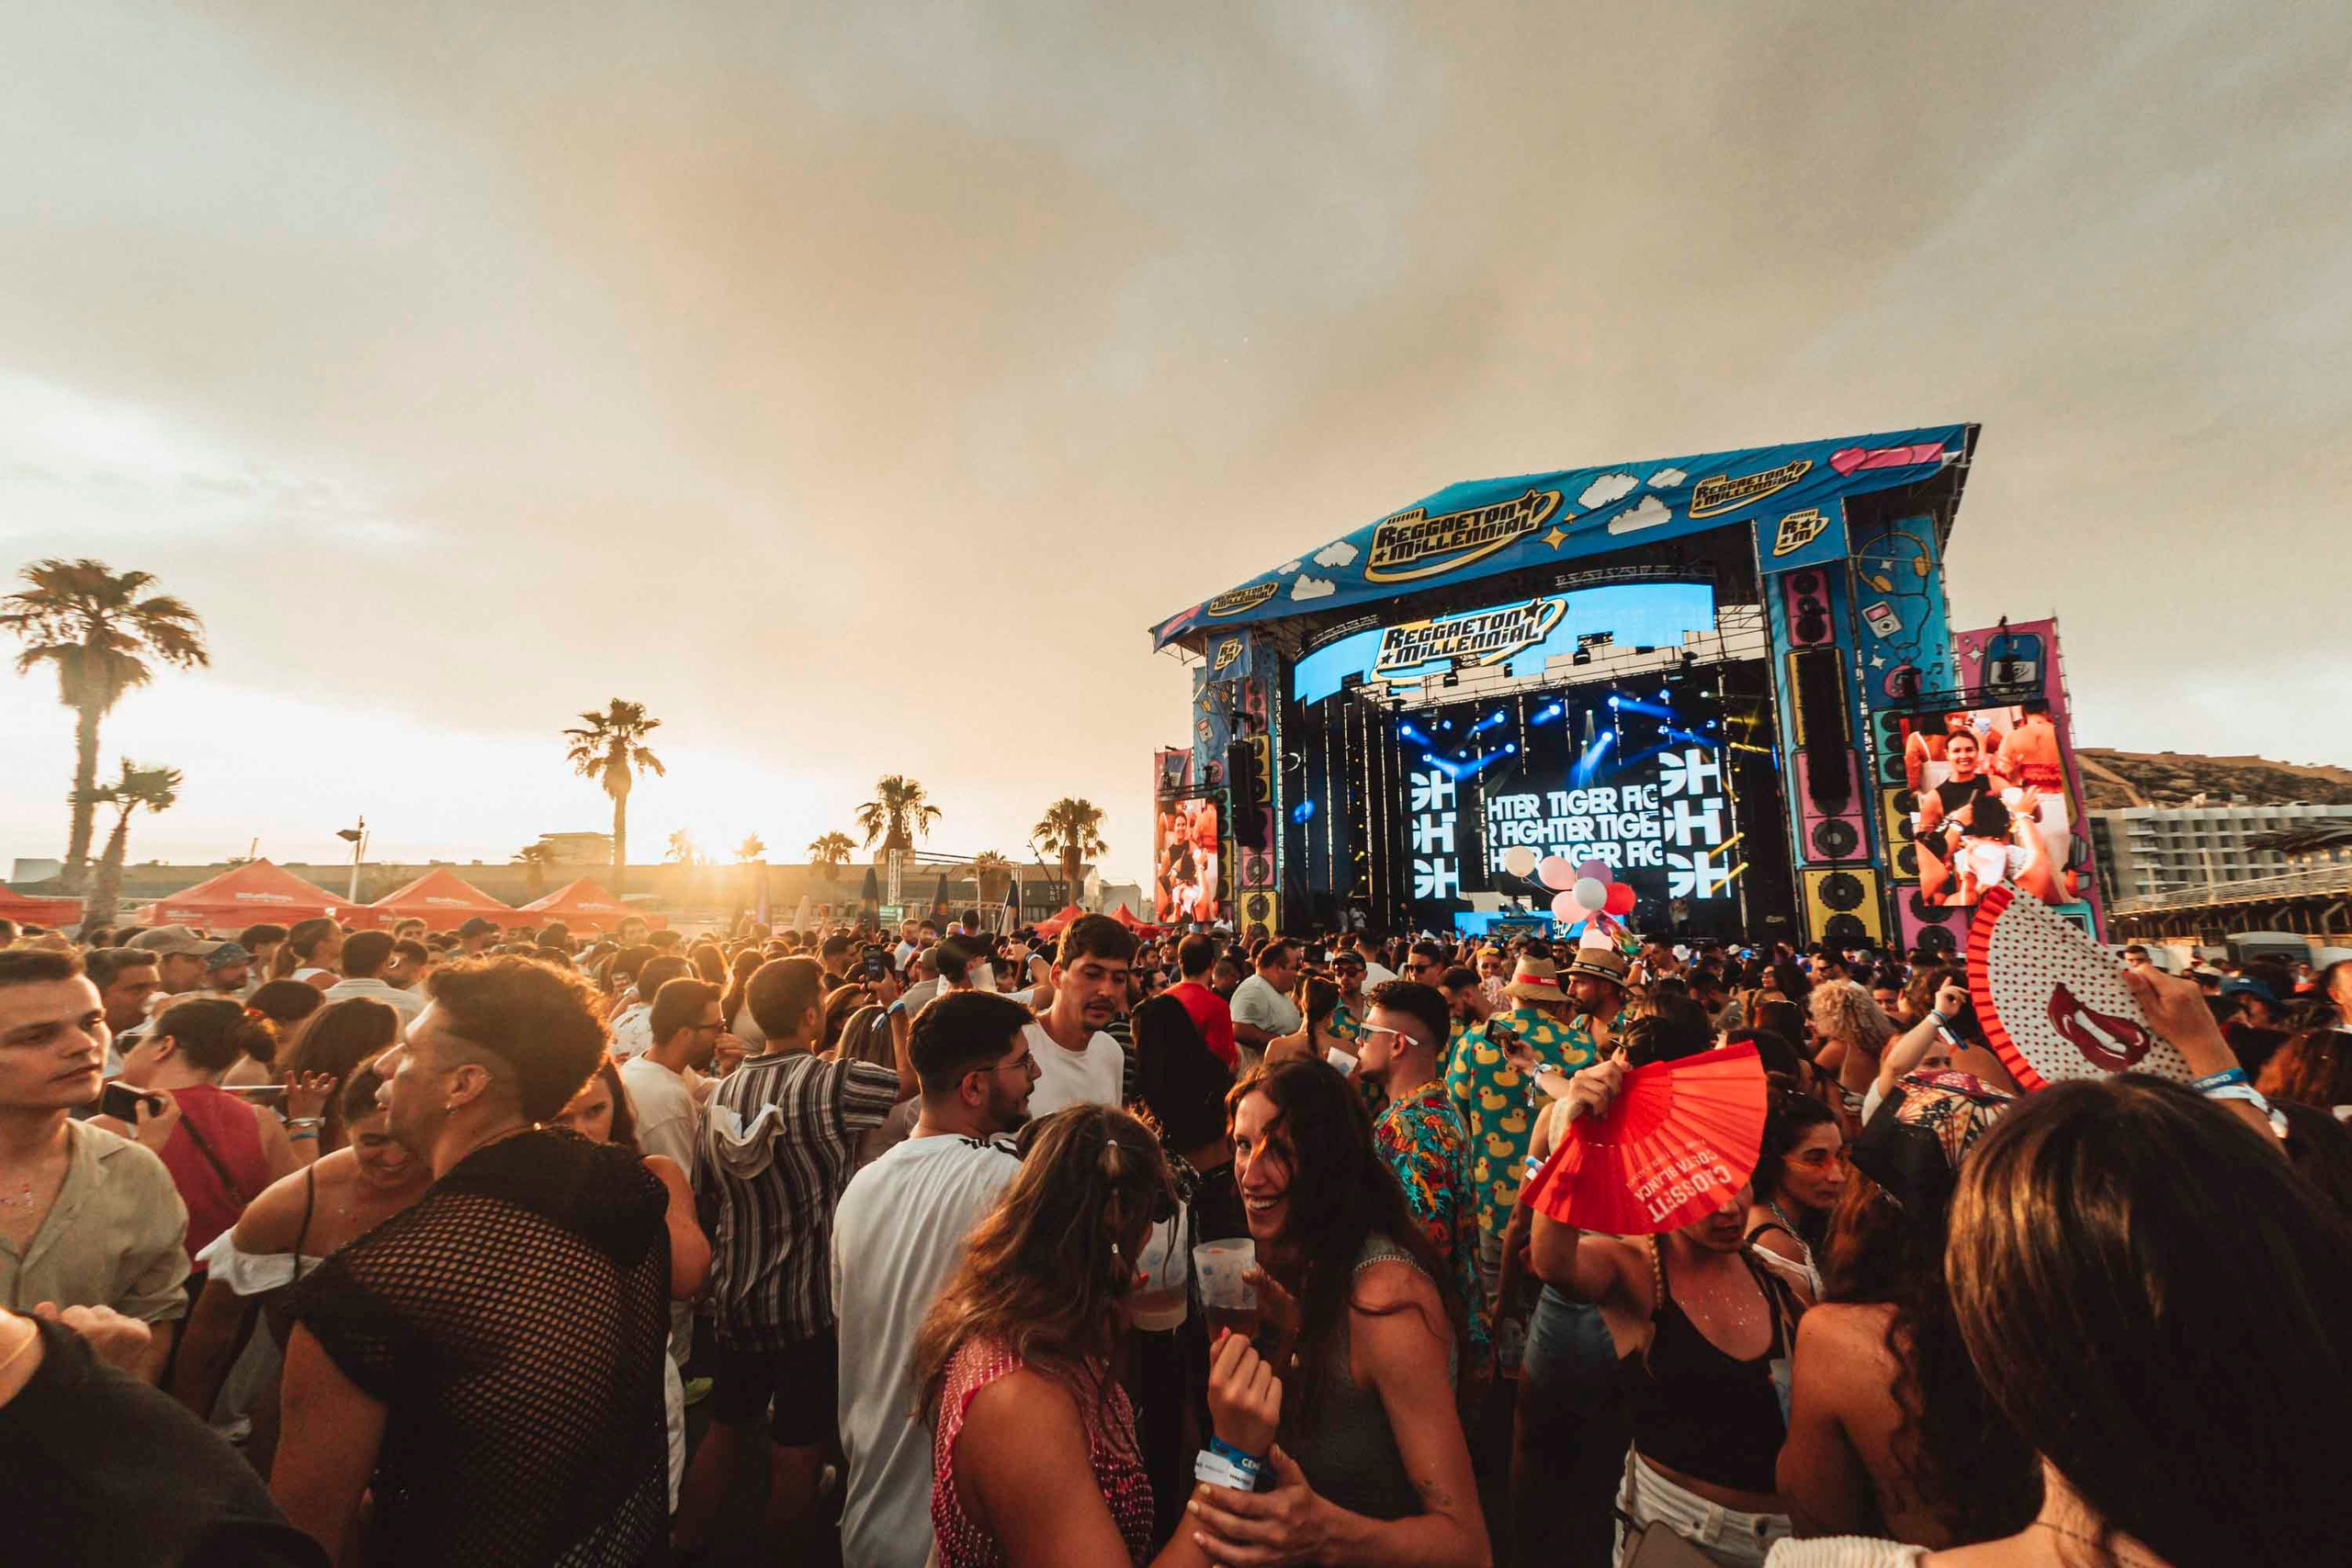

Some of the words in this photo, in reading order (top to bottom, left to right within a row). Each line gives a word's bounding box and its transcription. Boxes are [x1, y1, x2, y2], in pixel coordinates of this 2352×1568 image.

[1376, 503, 1514, 548] REGGAETON
[1383, 609, 1521, 650] REGGAETON
[1546, 786, 1619, 818] TIGER
[1501, 816, 1595, 846] FIGHTER
[1634, 1164, 1679, 1202] BLANCA
